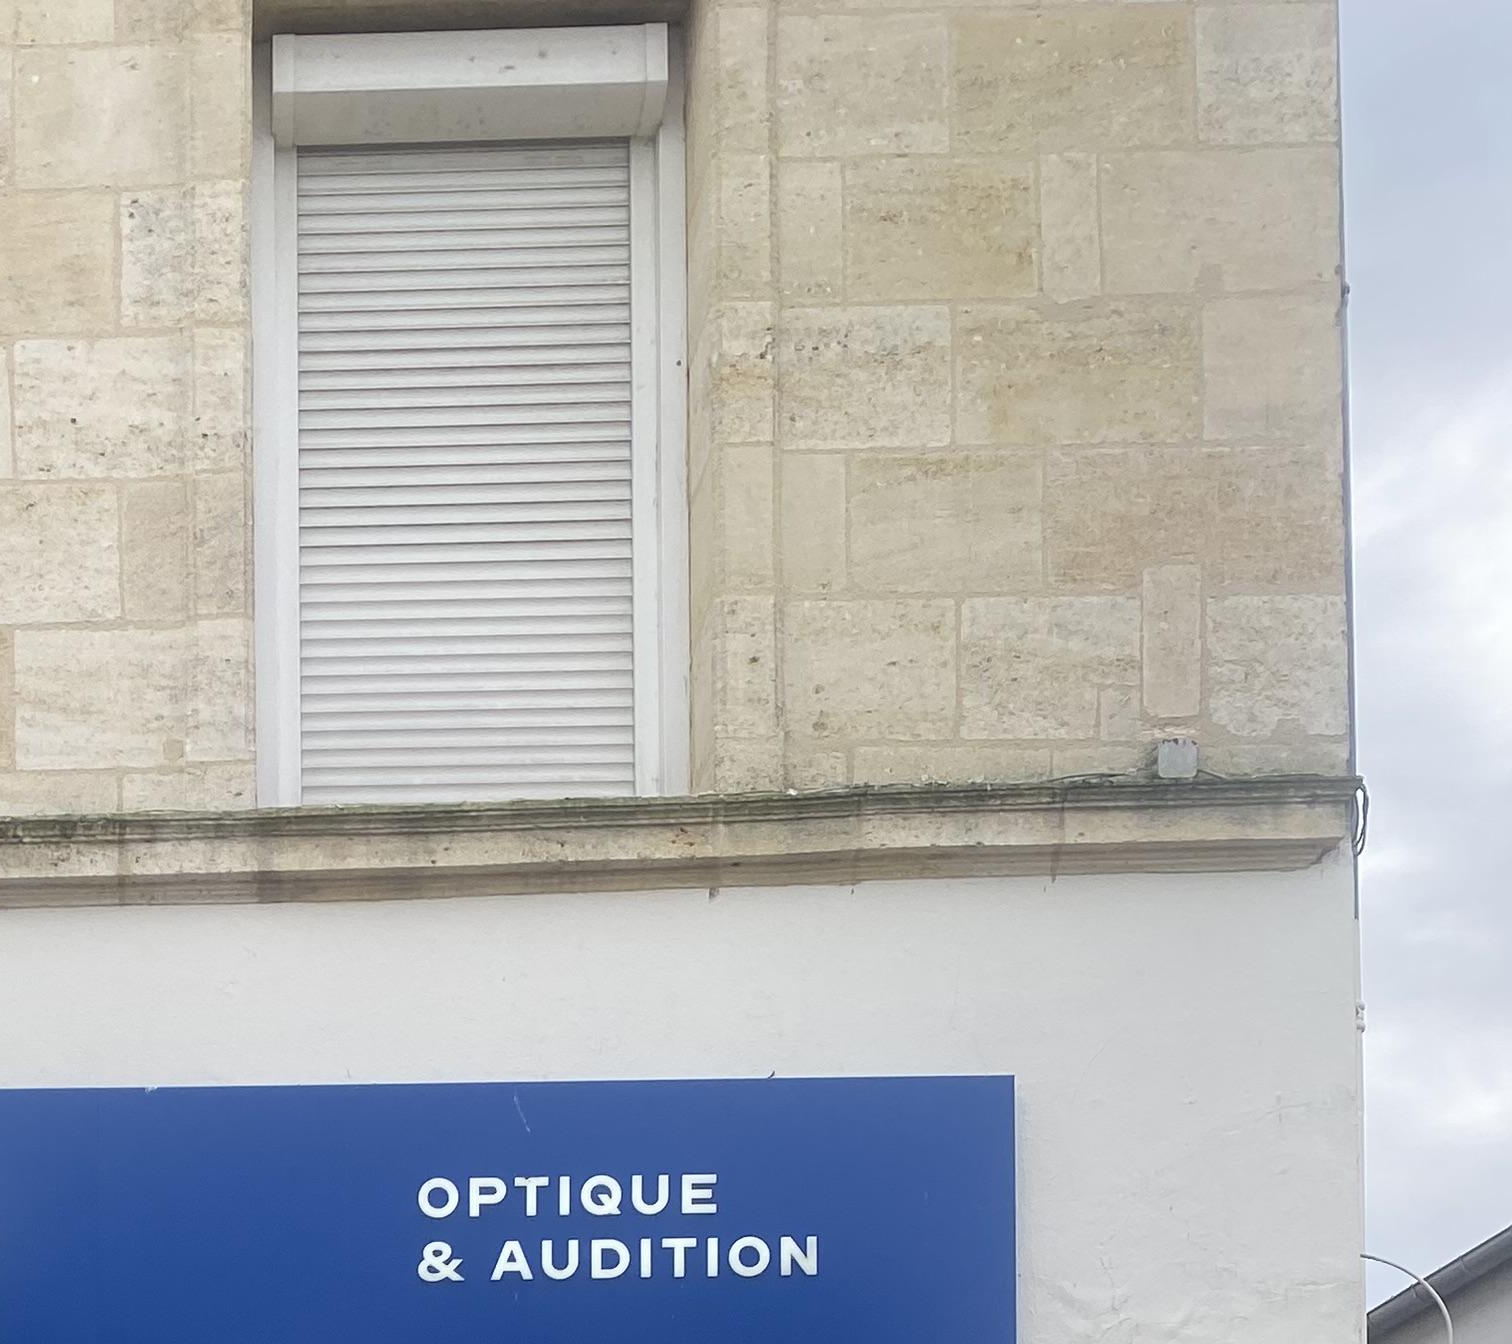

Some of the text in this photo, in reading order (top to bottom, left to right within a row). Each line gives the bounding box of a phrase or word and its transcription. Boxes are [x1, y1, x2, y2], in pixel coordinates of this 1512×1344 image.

[417, 1173, 719, 1218] OPTIQUE
[417, 1235, 819, 1283] & AUDITION
